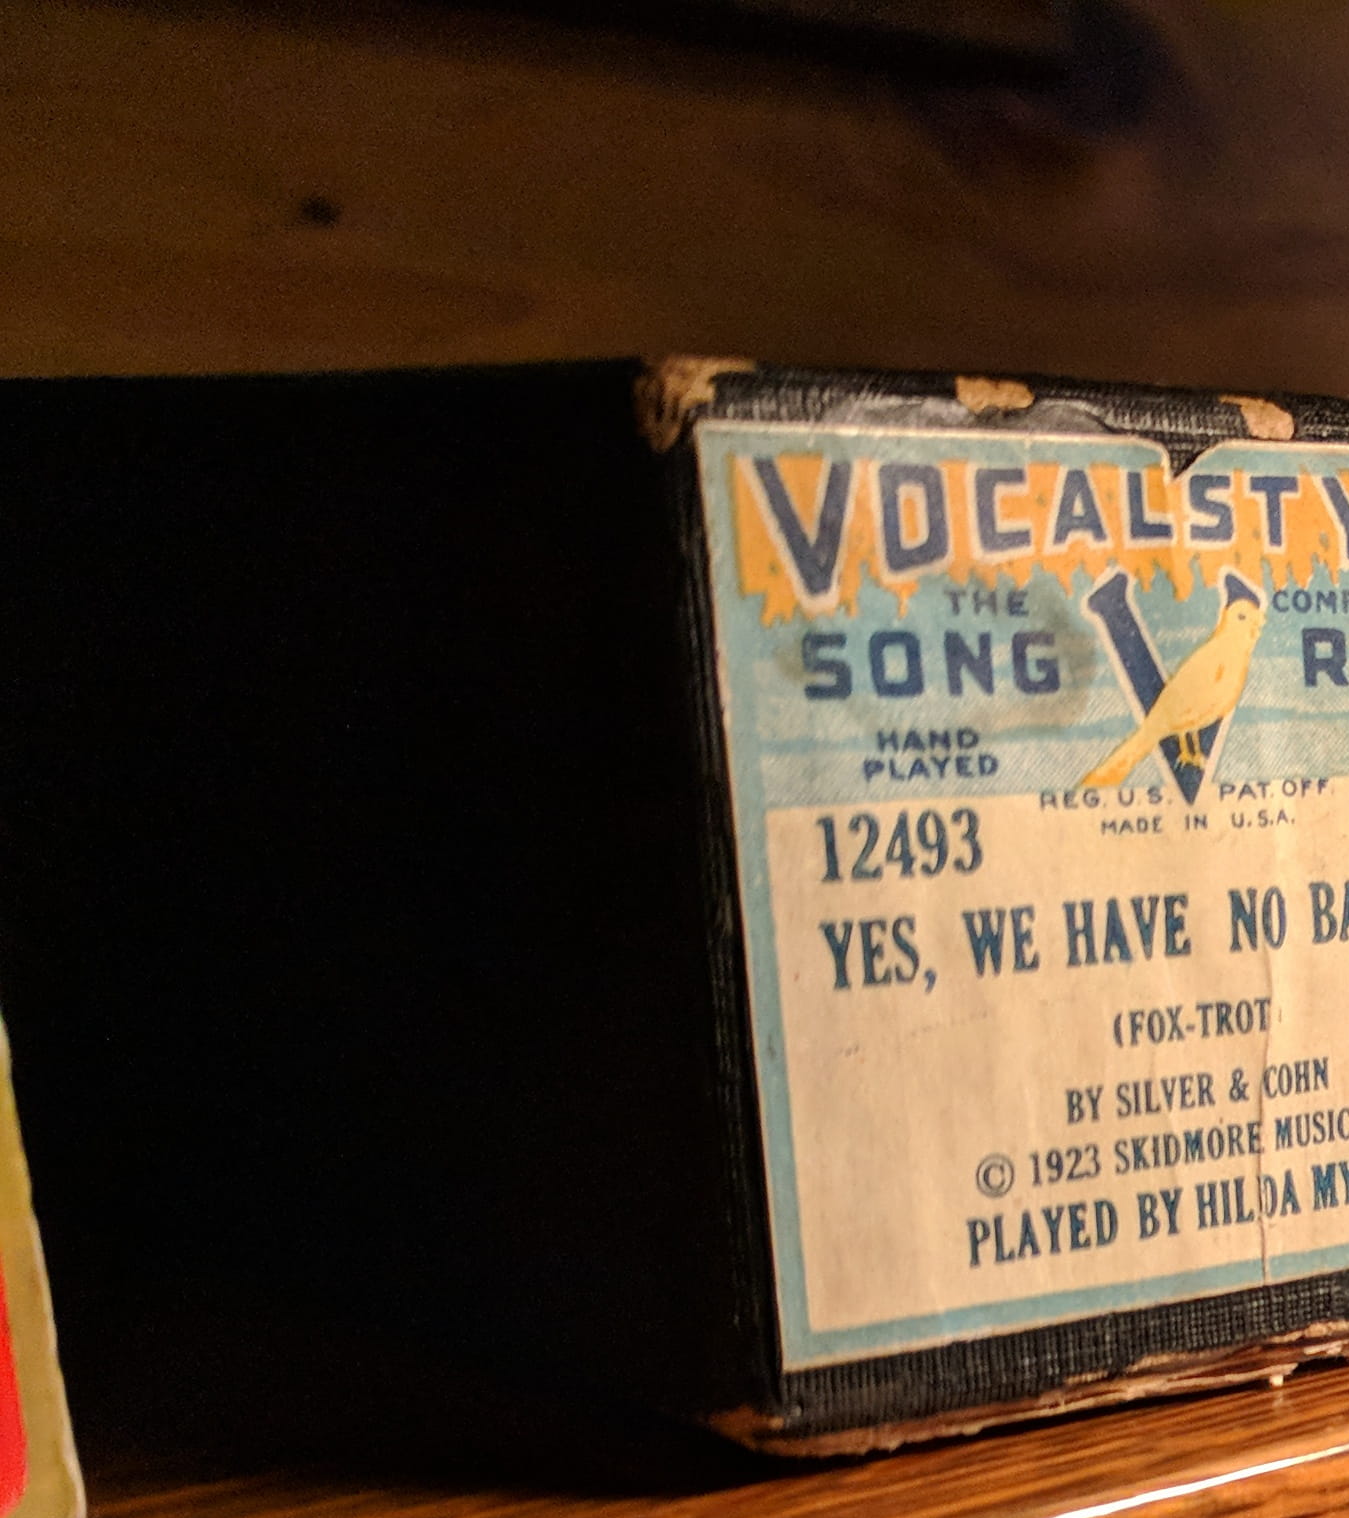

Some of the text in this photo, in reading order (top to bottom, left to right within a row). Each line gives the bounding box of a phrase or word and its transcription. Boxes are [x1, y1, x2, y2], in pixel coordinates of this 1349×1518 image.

[943, 590, 1031, 617] THE
[802, 631, 1060, 700] SONG
[862, 757, 999, 782] PLAYED
[877, 728, 980, 752] HAND
[815, 809, 984, 883] 12493
[1100, 807, 1296, 836] MADE IN U.S.A.
[820, 915, 937, 994] YES,
[962, 905, 1040, 977] WE
[1063, 893, 1192, 967] HAVE
[1229, 886, 1287, 953] NO
[1066, 1057, 1330, 1126] BY SILVER & COHN
[1029, 1143, 1102, 1188] 1923
[1114, 1120, 1263, 1175] SKIDMORE
[967, 1198, 1119, 1268] PLAYED
[1138, 1187, 1183, 1240] BY
[1196, 1170, 1301, 1230] HILDA
